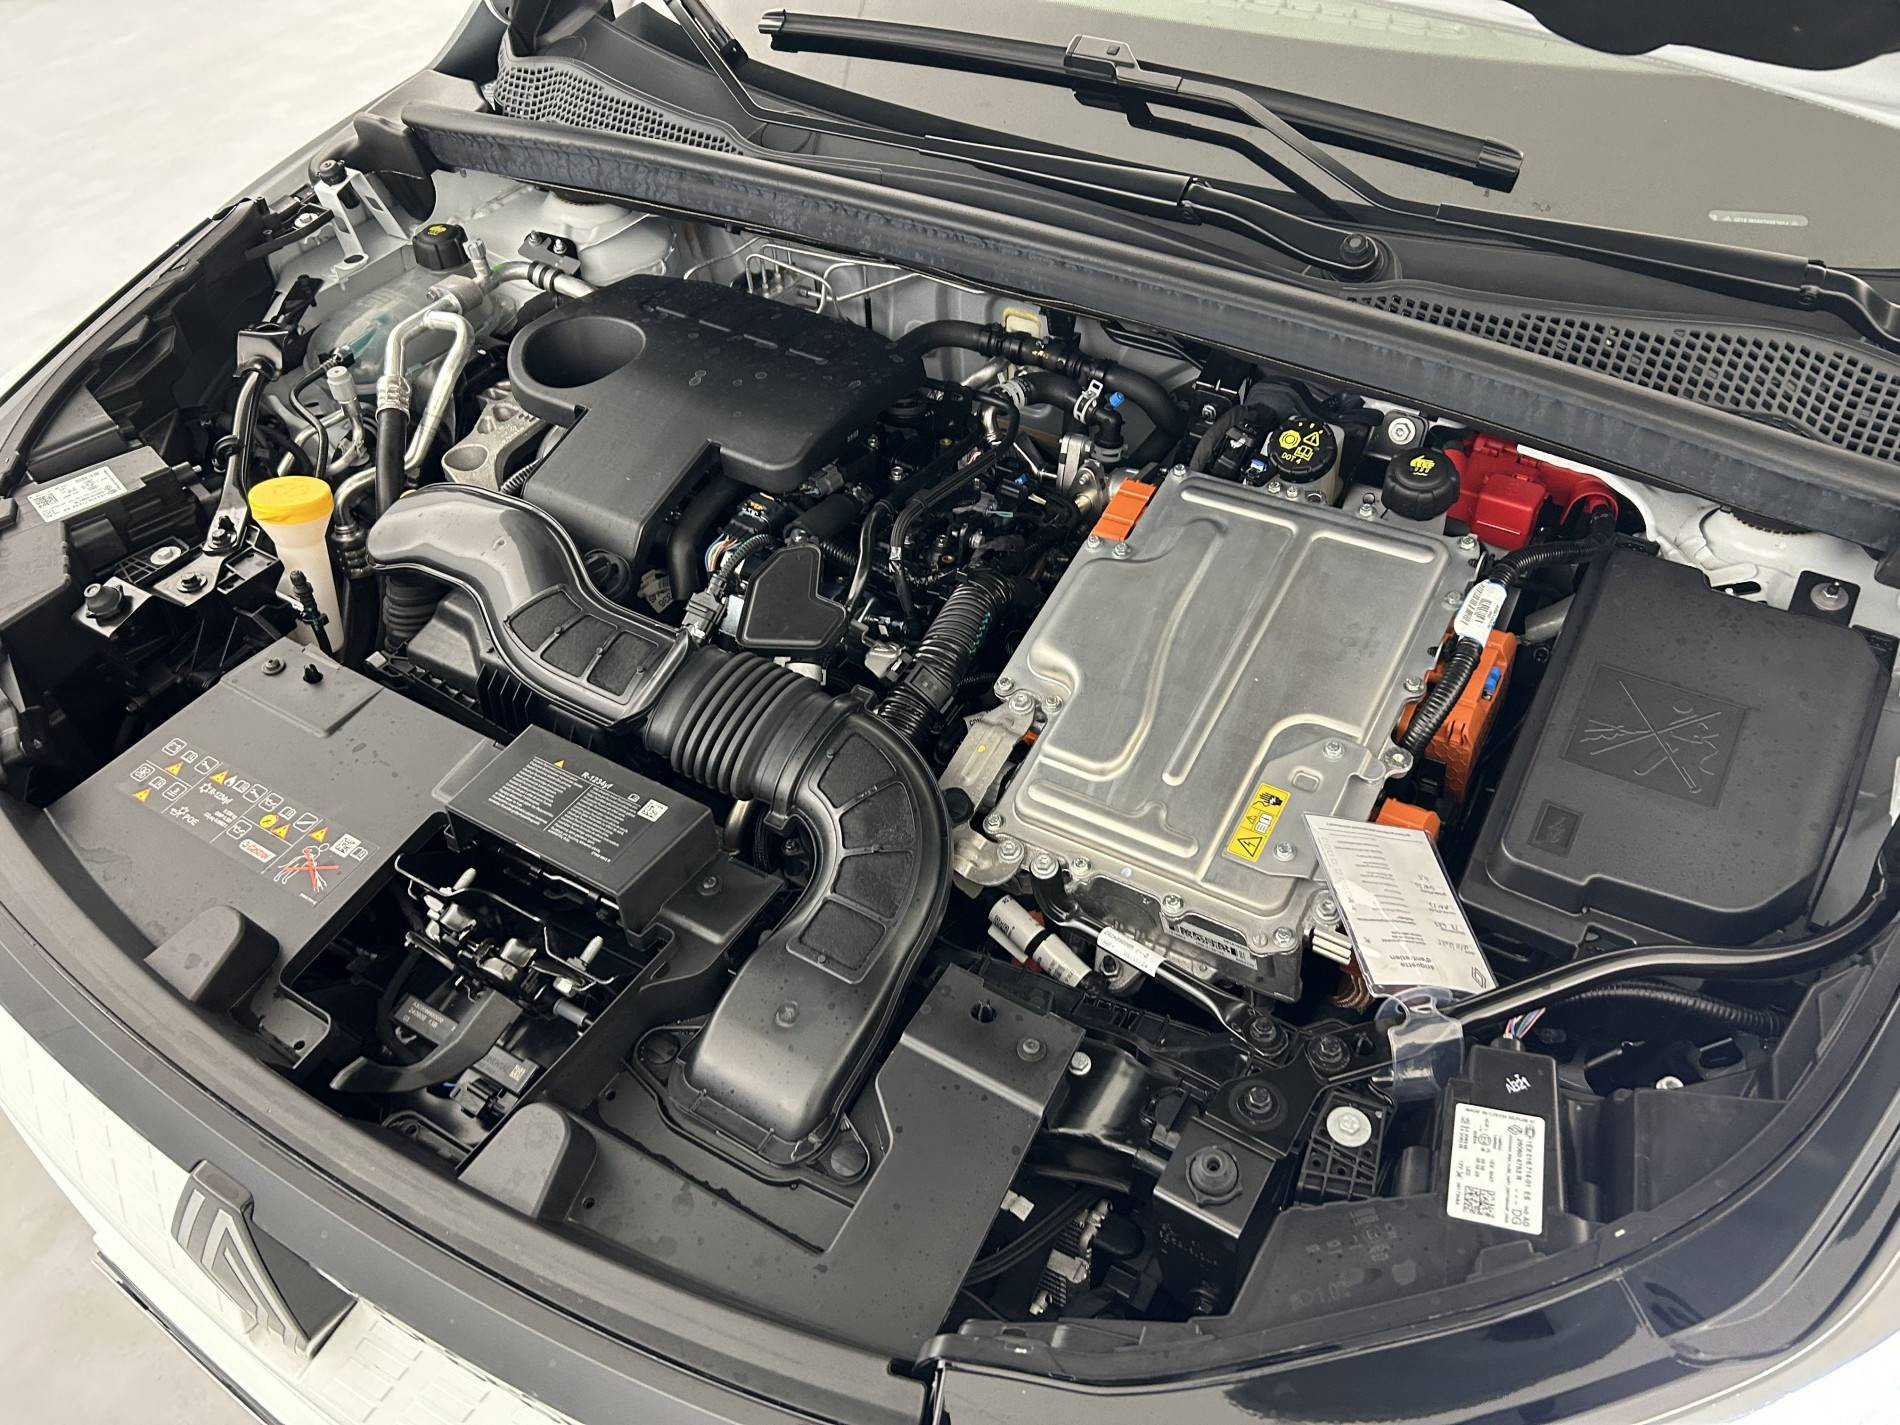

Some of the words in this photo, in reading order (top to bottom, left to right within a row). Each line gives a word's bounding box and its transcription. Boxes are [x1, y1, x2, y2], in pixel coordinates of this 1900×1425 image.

[1281, 452, 1296, 462] DOT
[581, 771, 613, 790] R-1234yf
[182, 814, 199, 826] POE
